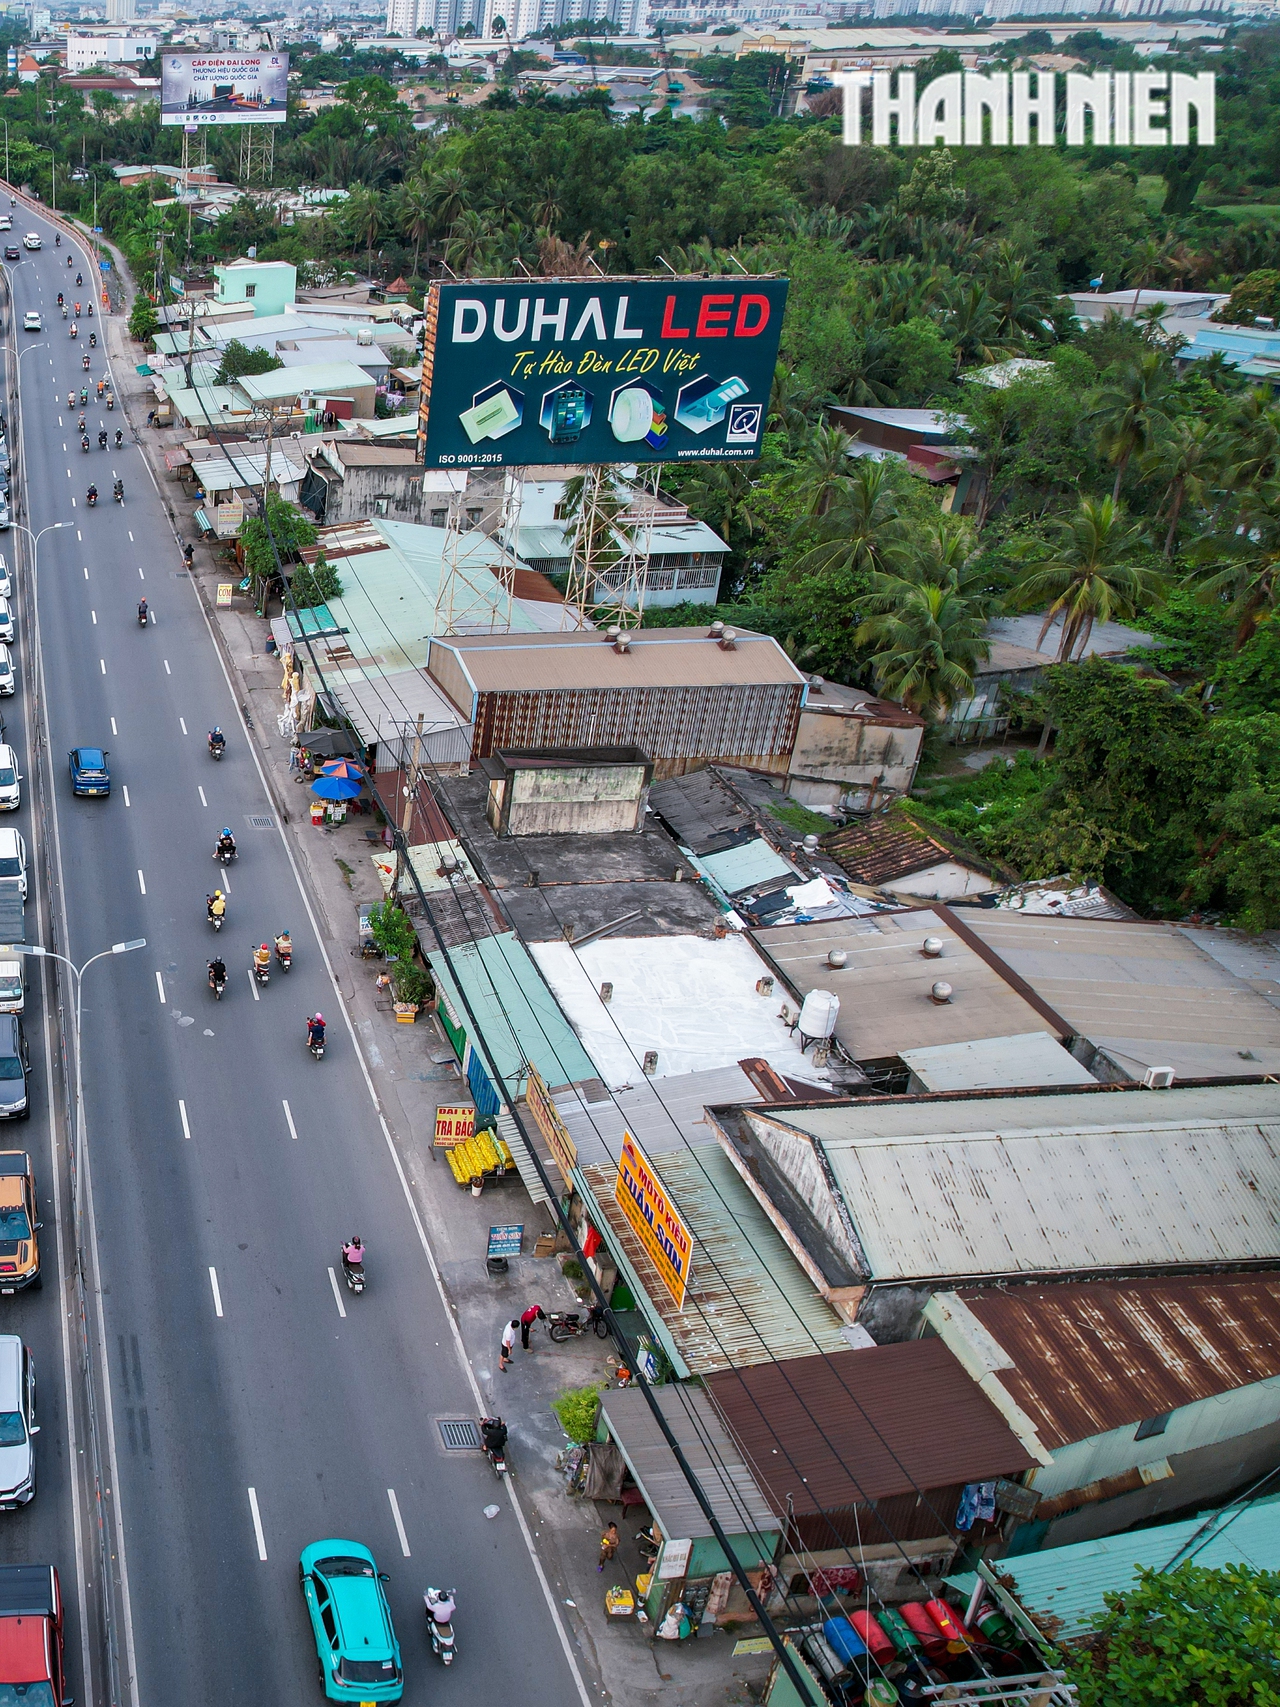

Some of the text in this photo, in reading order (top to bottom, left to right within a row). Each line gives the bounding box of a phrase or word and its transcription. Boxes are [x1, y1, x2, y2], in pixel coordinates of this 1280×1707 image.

[241, 58, 261, 66] LONG
[451, 294, 770, 342] DUHAL LED
[510, 348, 701, 380] Tự Hào Đèn LED Việt
[438, 453, 503, 463] ISO 9001:2015
[677, 447, 754, 458] www.duhal.com.vn
[436, 1118, 453, 1136] TRÀ
[656, 1222, 683, 1276] SƠN
